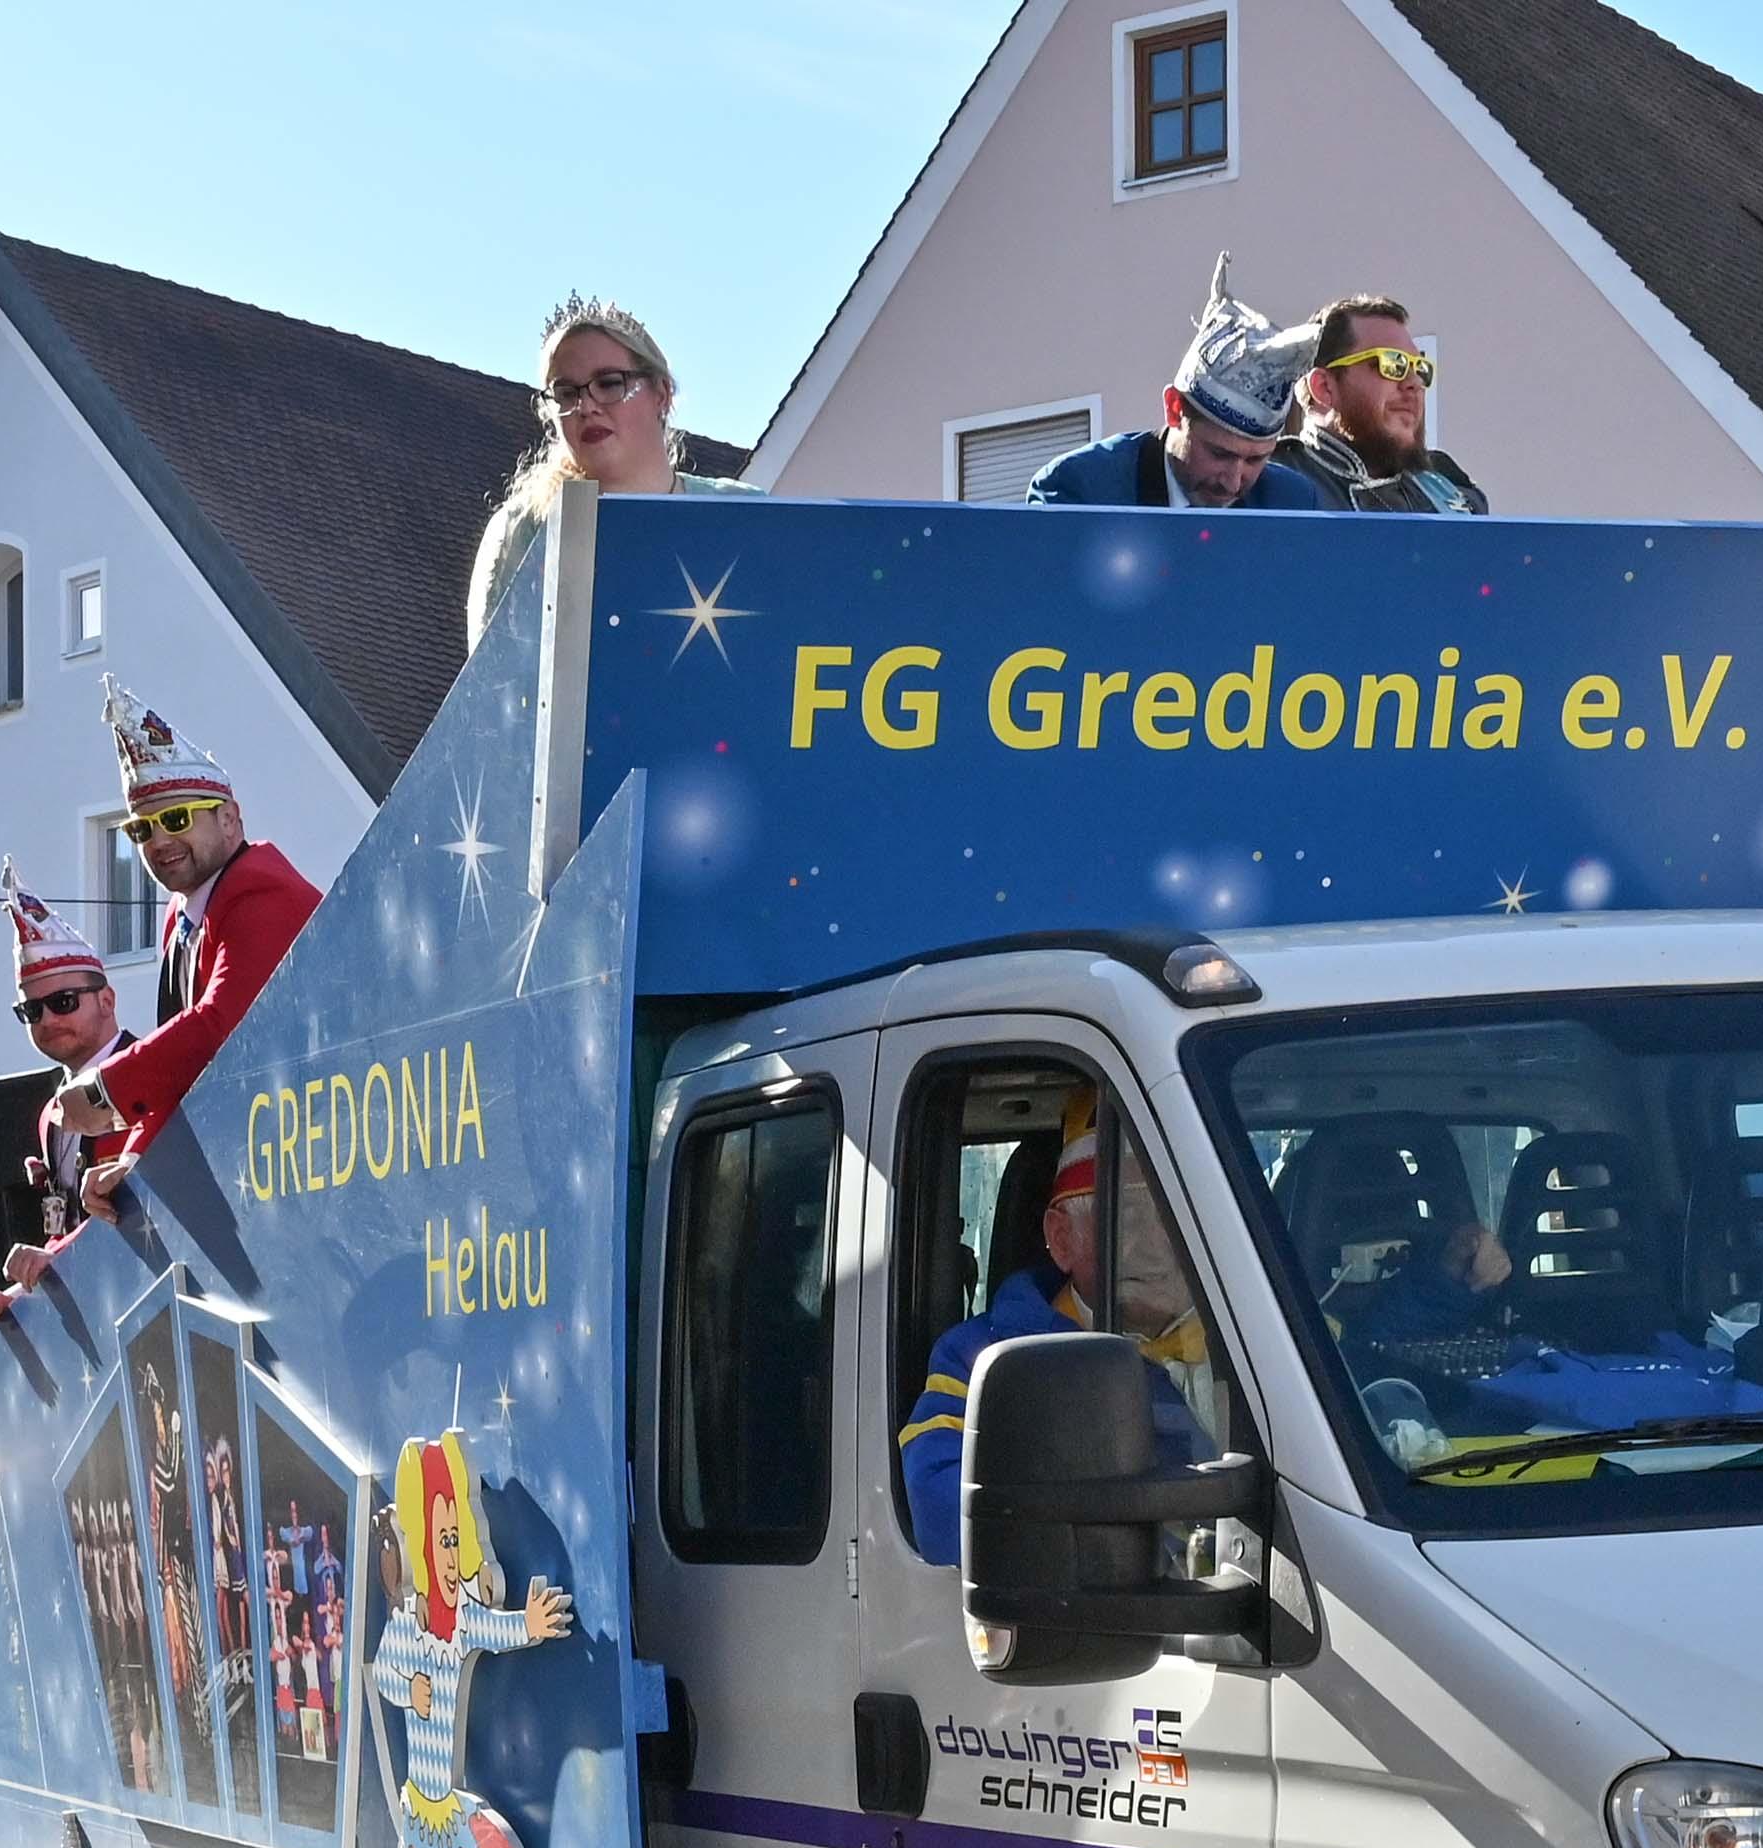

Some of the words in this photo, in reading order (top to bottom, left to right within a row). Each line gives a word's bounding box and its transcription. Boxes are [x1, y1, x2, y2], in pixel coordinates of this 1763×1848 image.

[790, 646, 942, 750] FG
[986, 645, 1523, 751] Gredonia
[1561, 653, 1748, 751] e.V.
[247, 1040, 486, 1201] GREDONIA
[425, 1205, 547, 1318] Helau
[935, 1714, 1132, 1778] dollinger
[980, 1767, 1187, 1828] schneider
